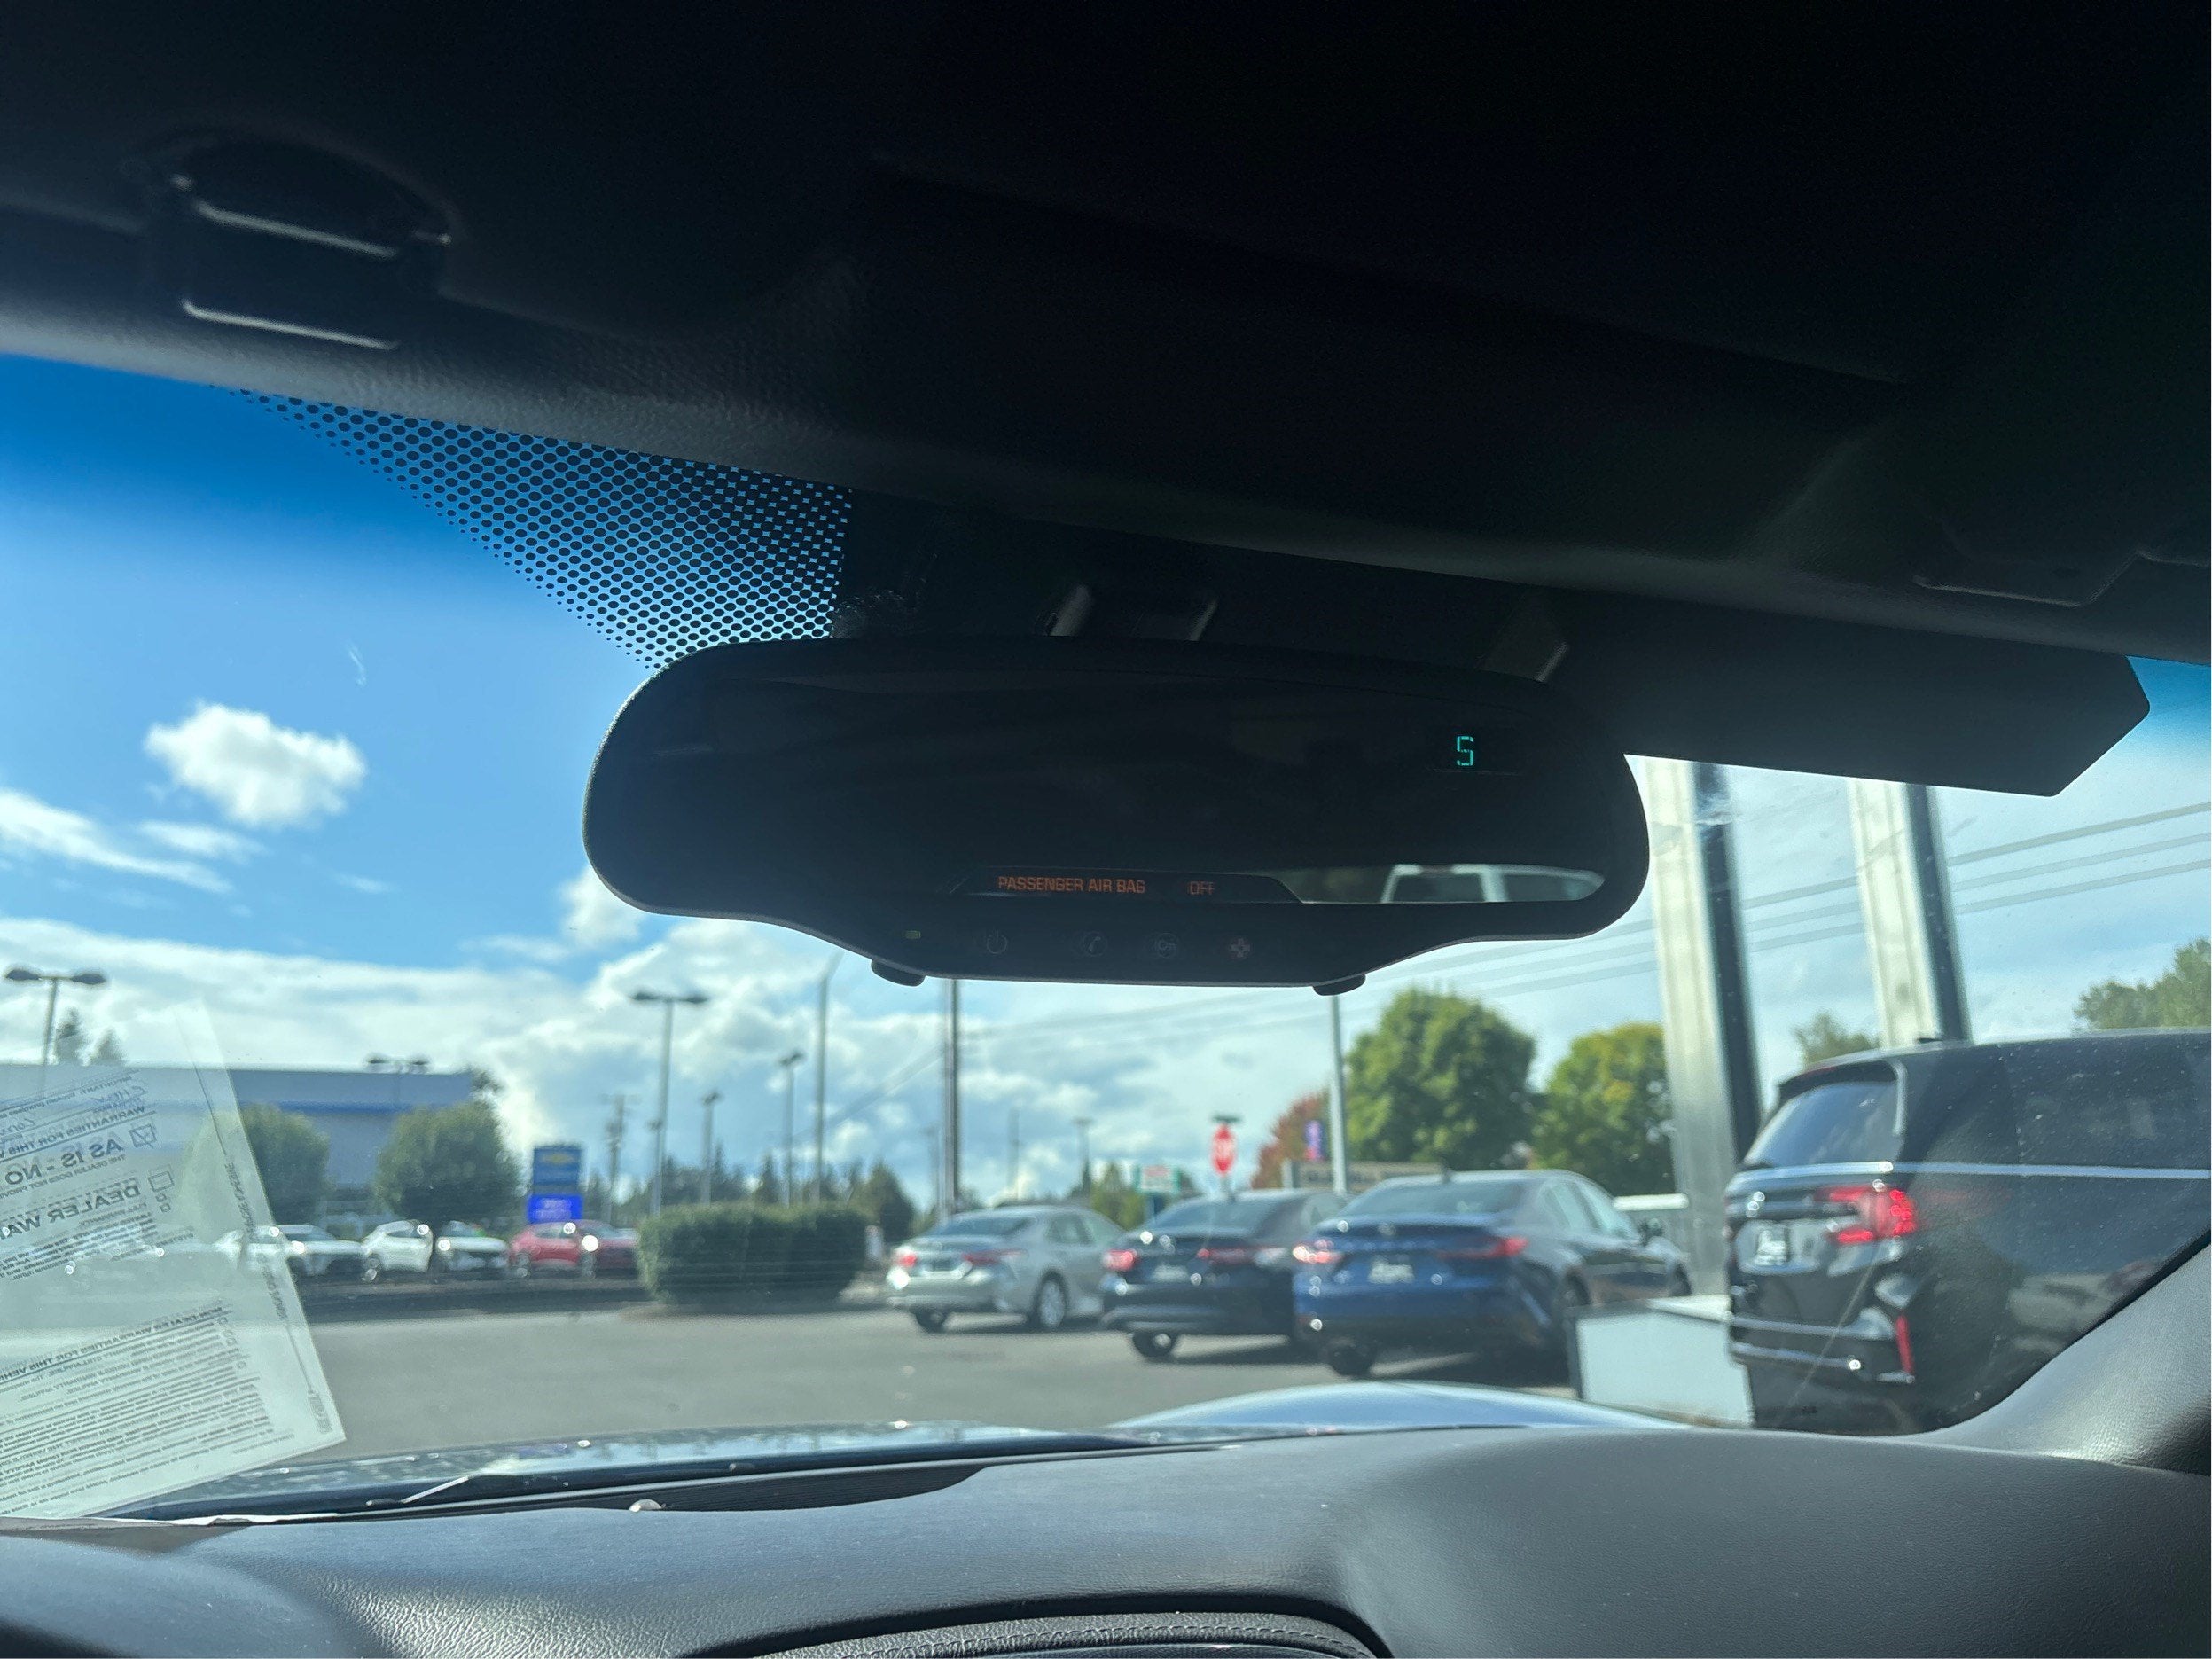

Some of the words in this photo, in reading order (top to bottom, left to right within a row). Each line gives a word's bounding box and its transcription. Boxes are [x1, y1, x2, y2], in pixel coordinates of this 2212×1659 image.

[1457, 736, 1474, 766] S
[998, 876, 1083, 893] PASSENGER
[1088, 877, 1113, 893] AIR
[1116, 878, 1145, 895] BAG
[1188, 880, 1215, 896] OFF
